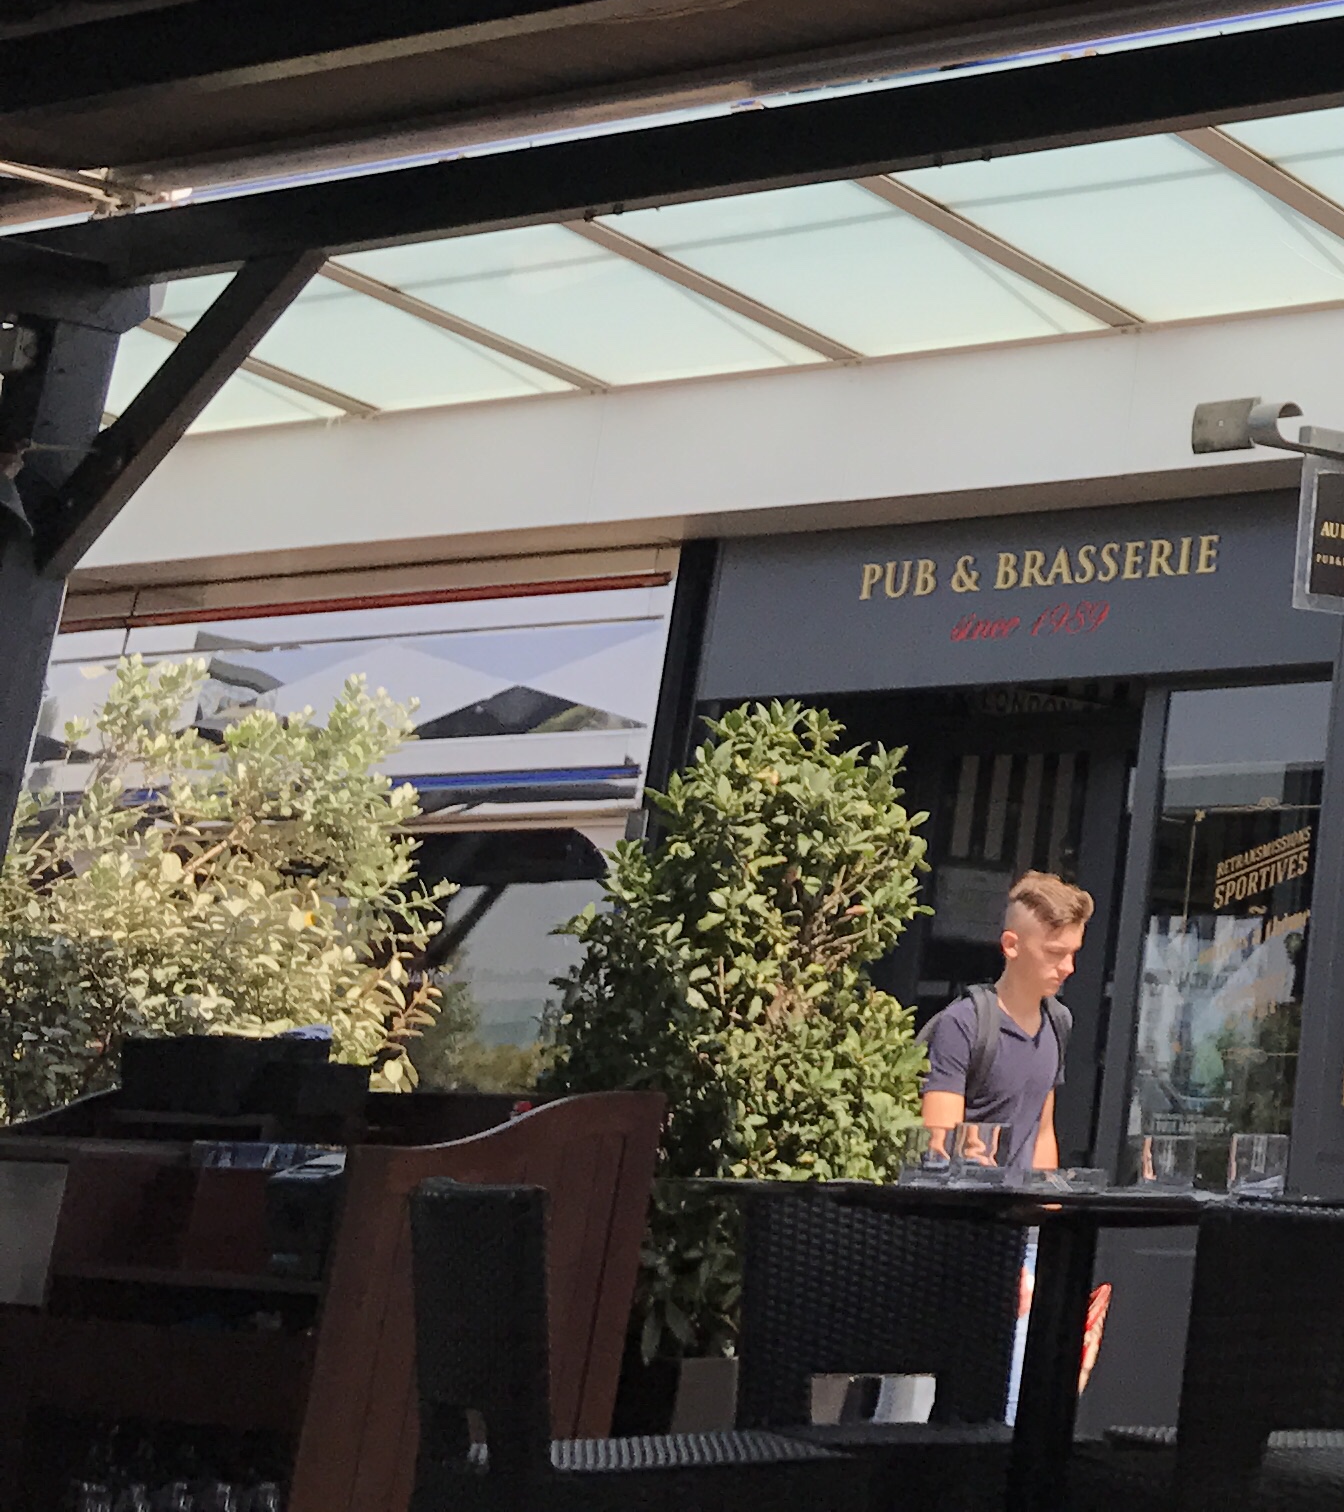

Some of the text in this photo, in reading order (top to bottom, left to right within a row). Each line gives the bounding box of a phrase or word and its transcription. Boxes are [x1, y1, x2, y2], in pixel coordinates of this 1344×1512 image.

[1320, 520, 1340, 538] AU
[859, 534, 1221, 600] PUB & BRASSERIE
[950, 600, 1111, 643] since 1989
[1215, 825, 1312, 878] RETRANSMISSIONS
[1213, 850, 1309, 911] SPORTIVES
